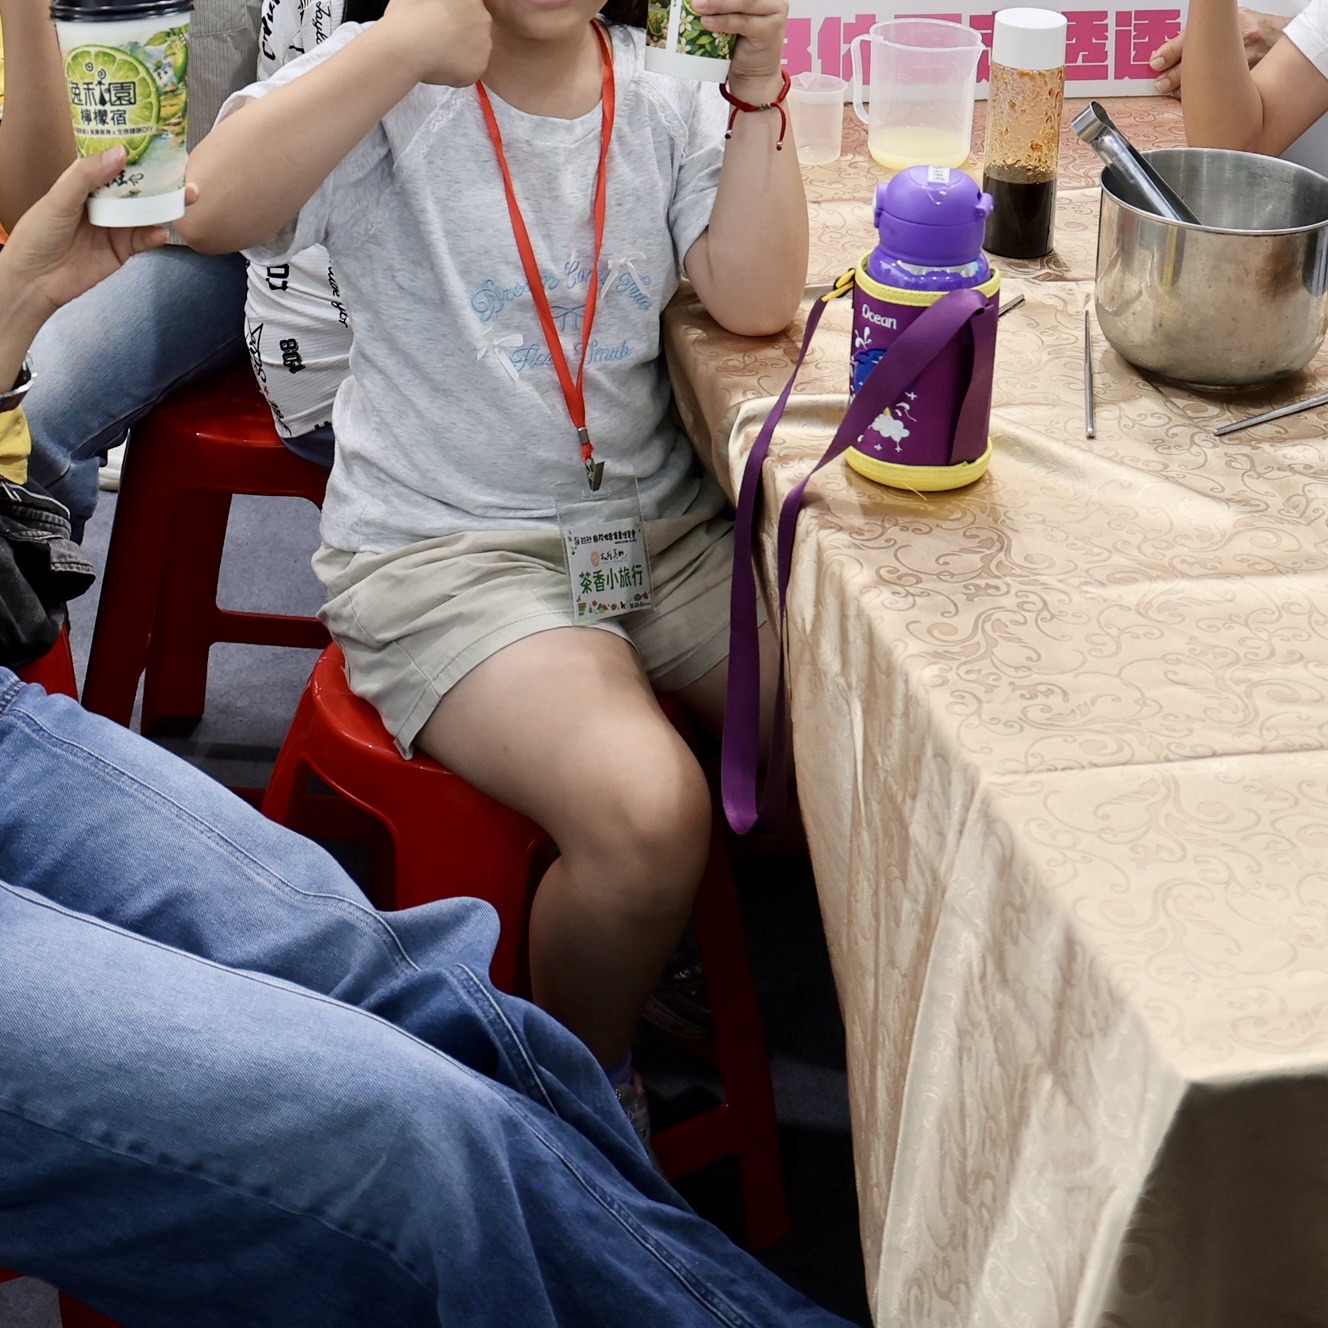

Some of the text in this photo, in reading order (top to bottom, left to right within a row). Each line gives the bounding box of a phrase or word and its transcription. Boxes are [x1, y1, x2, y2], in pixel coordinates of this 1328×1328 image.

[861, 303, 898, 331] Ocean
[579, 564, 644, 594] 茶香小旅行
